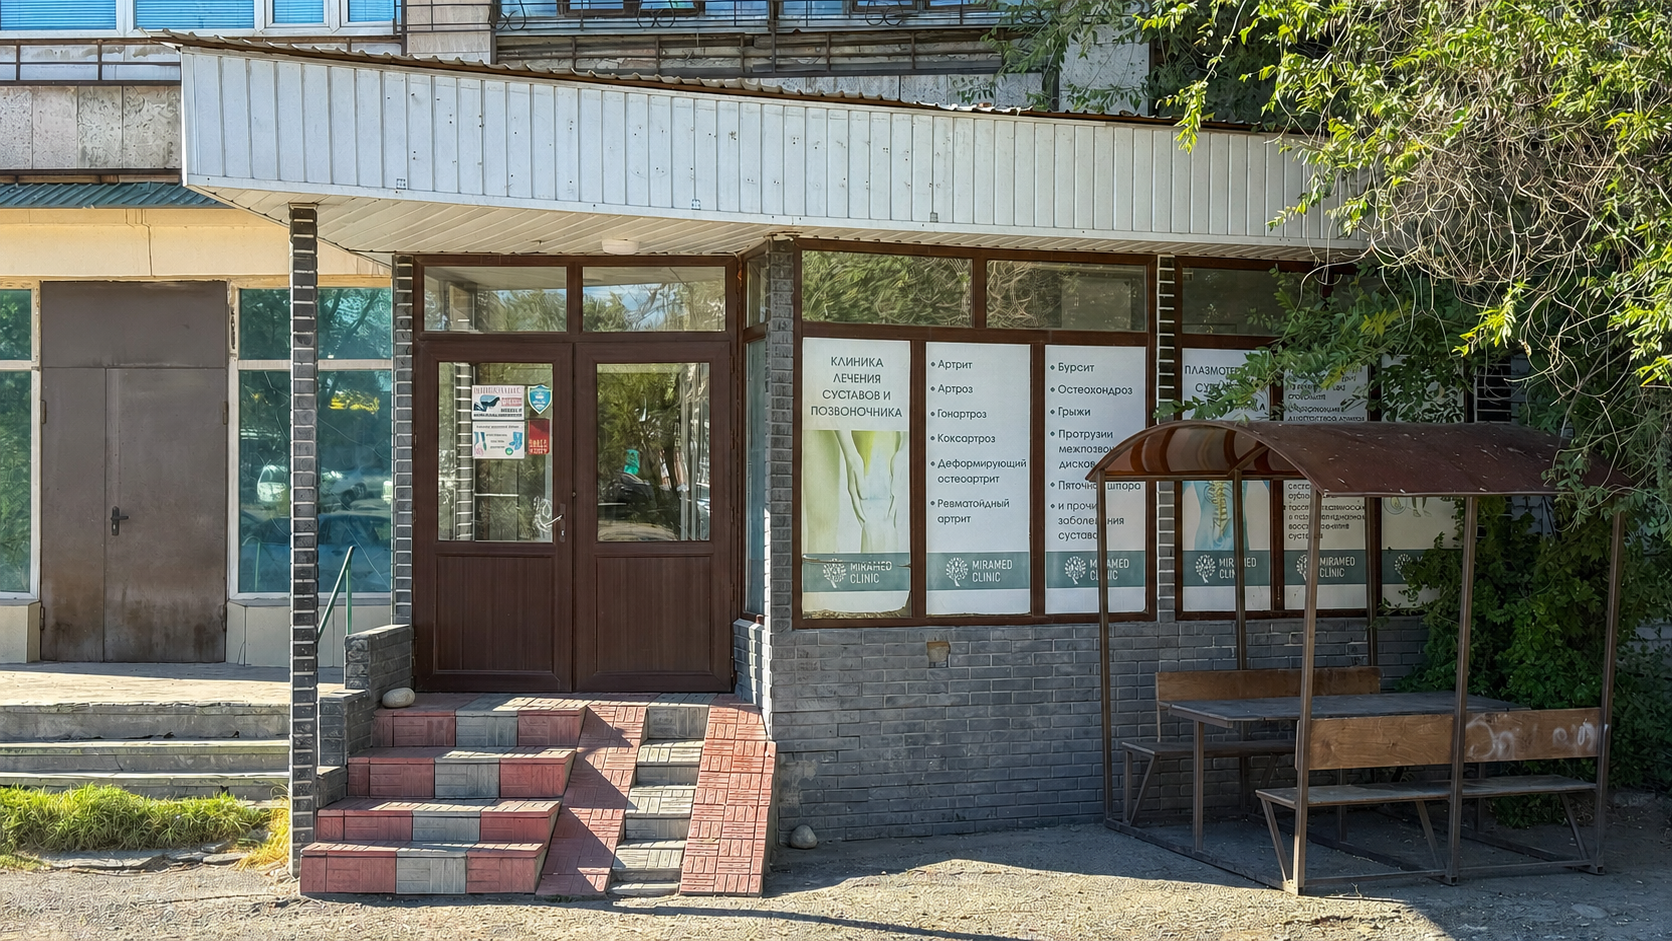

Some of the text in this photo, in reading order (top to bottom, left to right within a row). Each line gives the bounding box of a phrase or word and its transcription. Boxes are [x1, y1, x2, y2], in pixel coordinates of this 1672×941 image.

[831, 356, 884, 367] КЛИНИКА
[938, 360, 973, 370] Артрит
[1058, 362, 1095, 373] Бурсит
[833, 373, 881, 384] ЛЕЧЕНИЯ
[822, 389, 891, 400] СУСТАВОВ И
[938, 384, 974, 395] Артроз
[1058, 384, 1133, 396] Остеохондроз
[811, 406, 902, 417] ПОЗВОНОЧНИКА
[937, 409, 987, 420] Гонартроз
[1058, 406, 1091, 418] Грыжи
[937, 434, 996, 444] Коксартроз
[1058, 429, 1113, 440] Протрузии
[937, 459, 1027, 469] Деформирующий
[937, 475, 1000, 485] остеоартрит
[1107, 482, 1141, 492] шпора
[1066, 502, 1098, 512] прочи
[937, 515, 972, 525] артрит
[1058, 516, 1125, 525] заболения
[850, 560, 892, 571] MIRAMED
[972, 559, 1013, 570] MIRAMED
[1089, 558, 1130, 569] MAMED
[1218, 557, 1257, 568] MIRED
[1319, 556, 1356, 566] MIRAMED
[972, 572, 1001, 582] CLINIC
[1319, 567, 1345, 578] CLINIC
[850, 573, 880, 584] CLINIC
